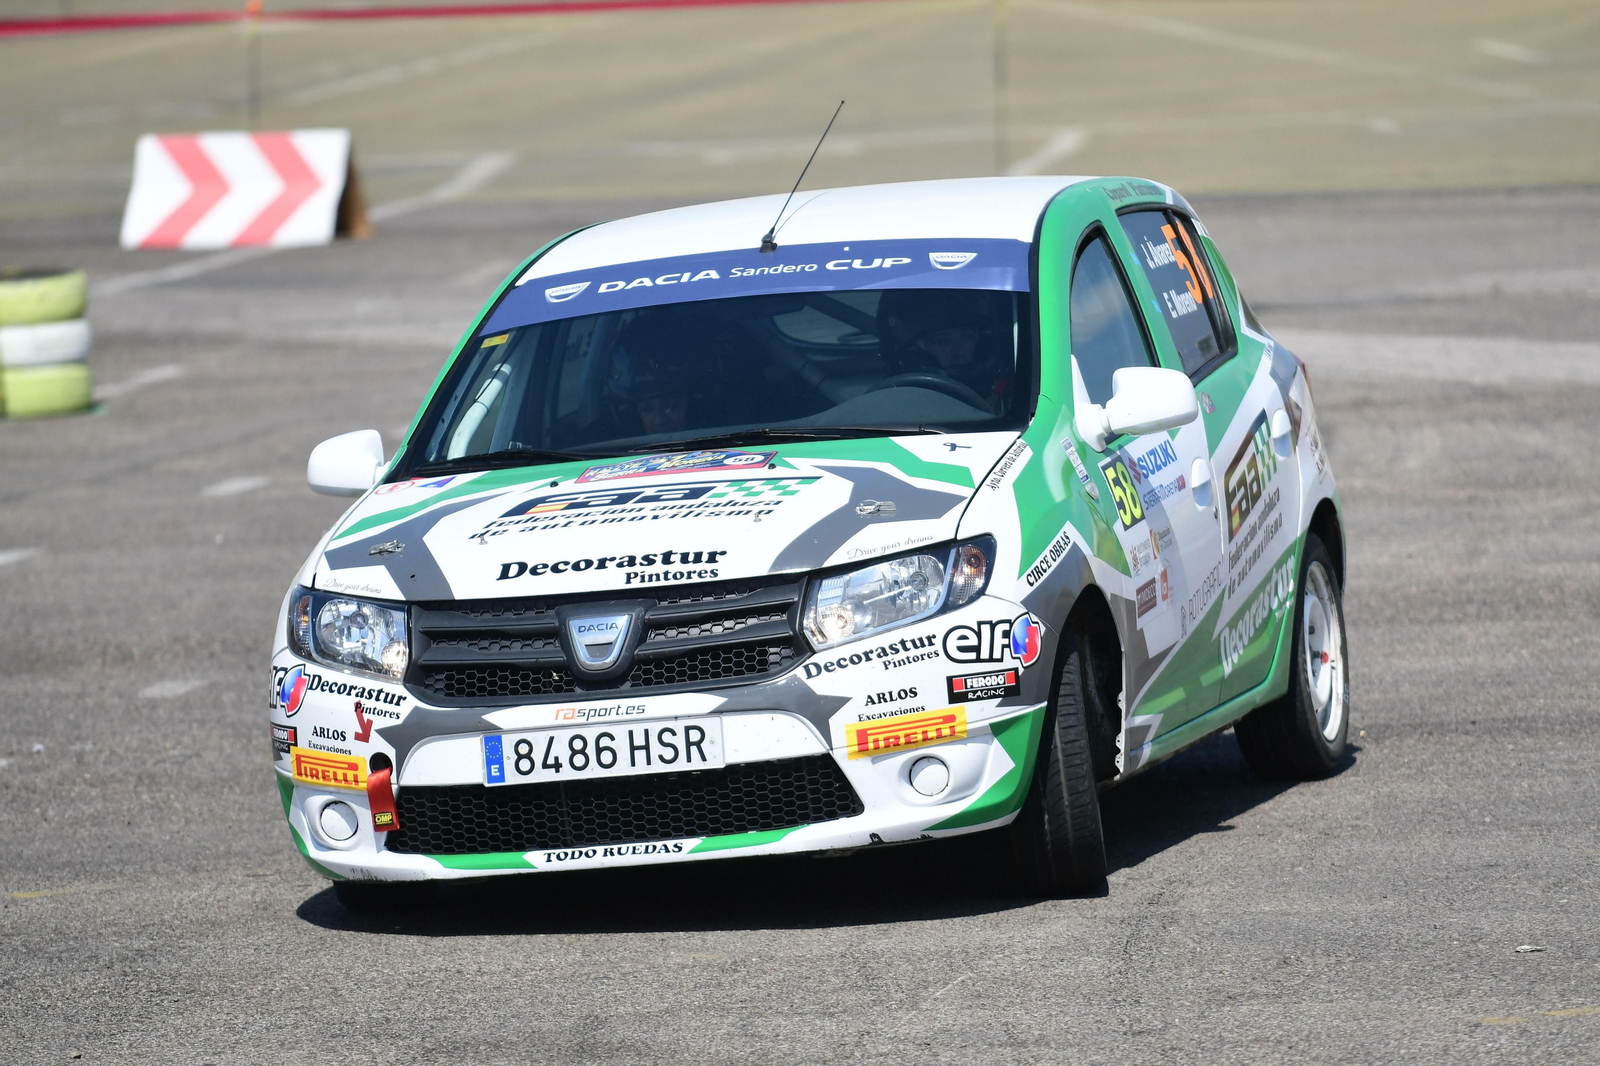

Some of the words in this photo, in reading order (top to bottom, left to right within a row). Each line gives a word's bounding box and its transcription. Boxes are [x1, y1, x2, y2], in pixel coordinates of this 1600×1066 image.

[1161, 220, 1213, 304] 58
[597, 269, 720, 293] DACIA
[729, 261, 817, 278] Sandero
[825, 257, 912, 271] CUP
[1137, 439, 1178, 479] SUZUKI
[1104, 461, 1142, 527] 58
[649, 499, 784, 512] andaluza
[518, 508, 776, 532] automovilismo
[496, 550, 728, 581] Decorastur
[1026, 548, 1052, 587] CIRCE
[1050, 531, 1071, 563] OBRAS
[625, 565, 719, 584] Pintores
[1221, 555, 1295, 679] Decorastur
[578, 623, 618, 633] DACIA
[942, 619, 1014, 663] elf
[803, 633, 937, 679] Decorastur
[883, 649, 940, 670] Pintores
[309, 674, 407, 706] Decorastur
[966, 675, 1006, 689] FERODO
[864, 686, 918, 706] ARLOS
[968, 687, 1005, 699] RACING
[354, 702, 401, 720] Pintores
[555, 704, 646, 721] rasport.es
[858, 705, 926, 722] Excavaciones
[312, 725, 347, 741] ARLOS
[856, 713, 956, 752] PIRELLI
[308, 740, 352, 755] Excavaciones
[514, 732, 618, 776] 8486
[628, 725, 708, 767] HSR
[295, 754, 360, 786] PIRELLI
[491, 764, 499, 776] E
[375, 814, 393, 823] OMP
[544, 849, 597, 863] TODO
[602, 842, 683, 857] RUEDAS
